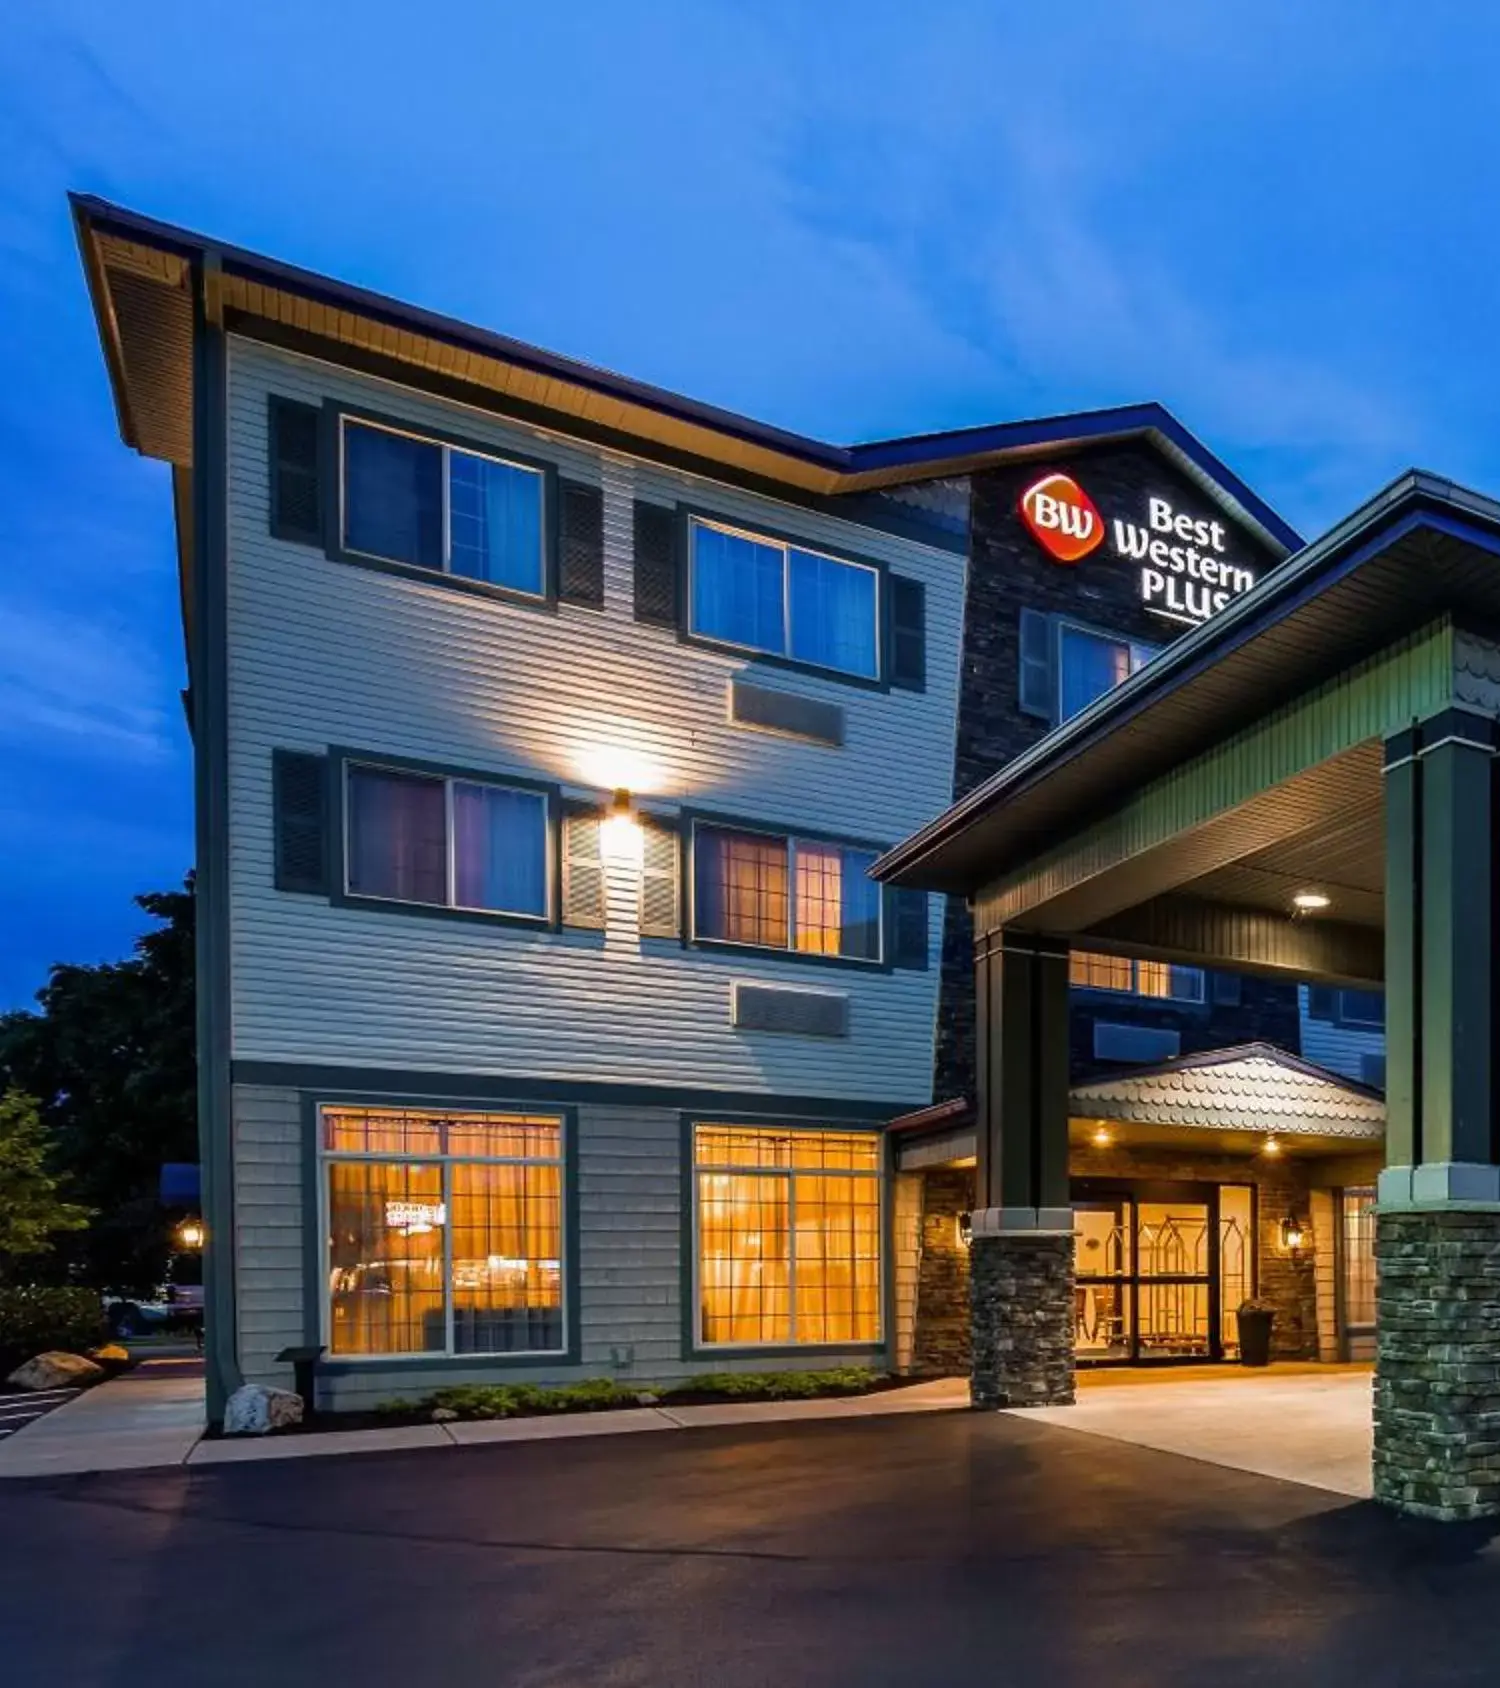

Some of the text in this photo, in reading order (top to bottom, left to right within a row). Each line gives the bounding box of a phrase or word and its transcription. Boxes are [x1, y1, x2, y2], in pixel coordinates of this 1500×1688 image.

[1034, 493, 1093, 539] BW
[1149, 497, 1225, 551] Best
[1114, 520, 1253, 592] Western
